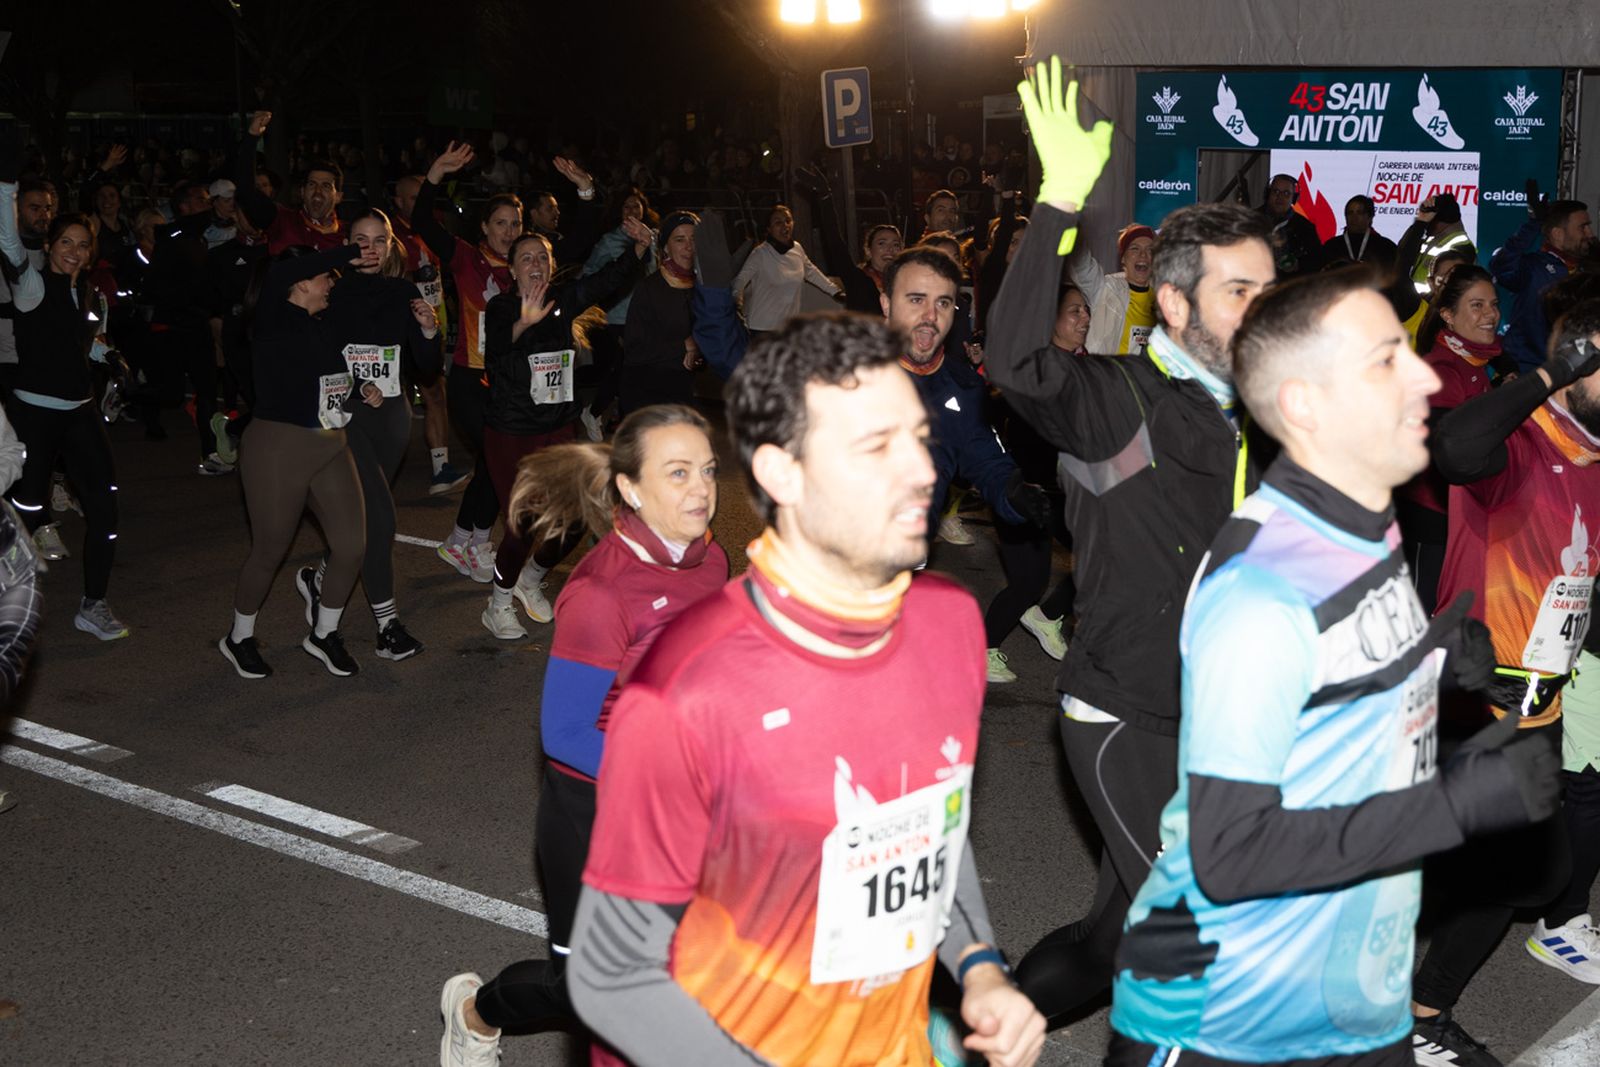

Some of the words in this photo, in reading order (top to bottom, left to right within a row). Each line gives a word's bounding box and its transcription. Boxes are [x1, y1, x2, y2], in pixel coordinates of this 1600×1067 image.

[447, 88, 480, 111] WC
[1289, 82, 1326, 112] 43
[1326, 82, 1391, 110] SAN
[834, 79, 861, 137] P
[1164, 115, 1186, 123] RURAL
[1226, 115, 1244, 134] 43
[1279, 107, 1384, 143] ANTÓN
[1427, 116, 1448, 137] 43
[1494, 118, 1515, 126] CAJA
[1516, 118, 1545, 126] RURAL
[1378, 161, 1412, 170] CARRERA
[1414, 162, 1445, 170] URBANA
[1138, 179, 1191, 191] calderón
[1376, 172, 1409, 181] NOCHE
[1411, 173, 1424, 182] DE
[1372, 183, 1422, 204] SAN
[1390, 207, 1415, 215] ENERO
[352, 362, 390, 378] 6364
[544, 370, 562, 387] 122
[1552, 599, 1569, 609] SAN
[868, 820, 910, 842] NOCHE
[847, 854, 877, 872] SAN
[862, 845, 946, 918] 1645
